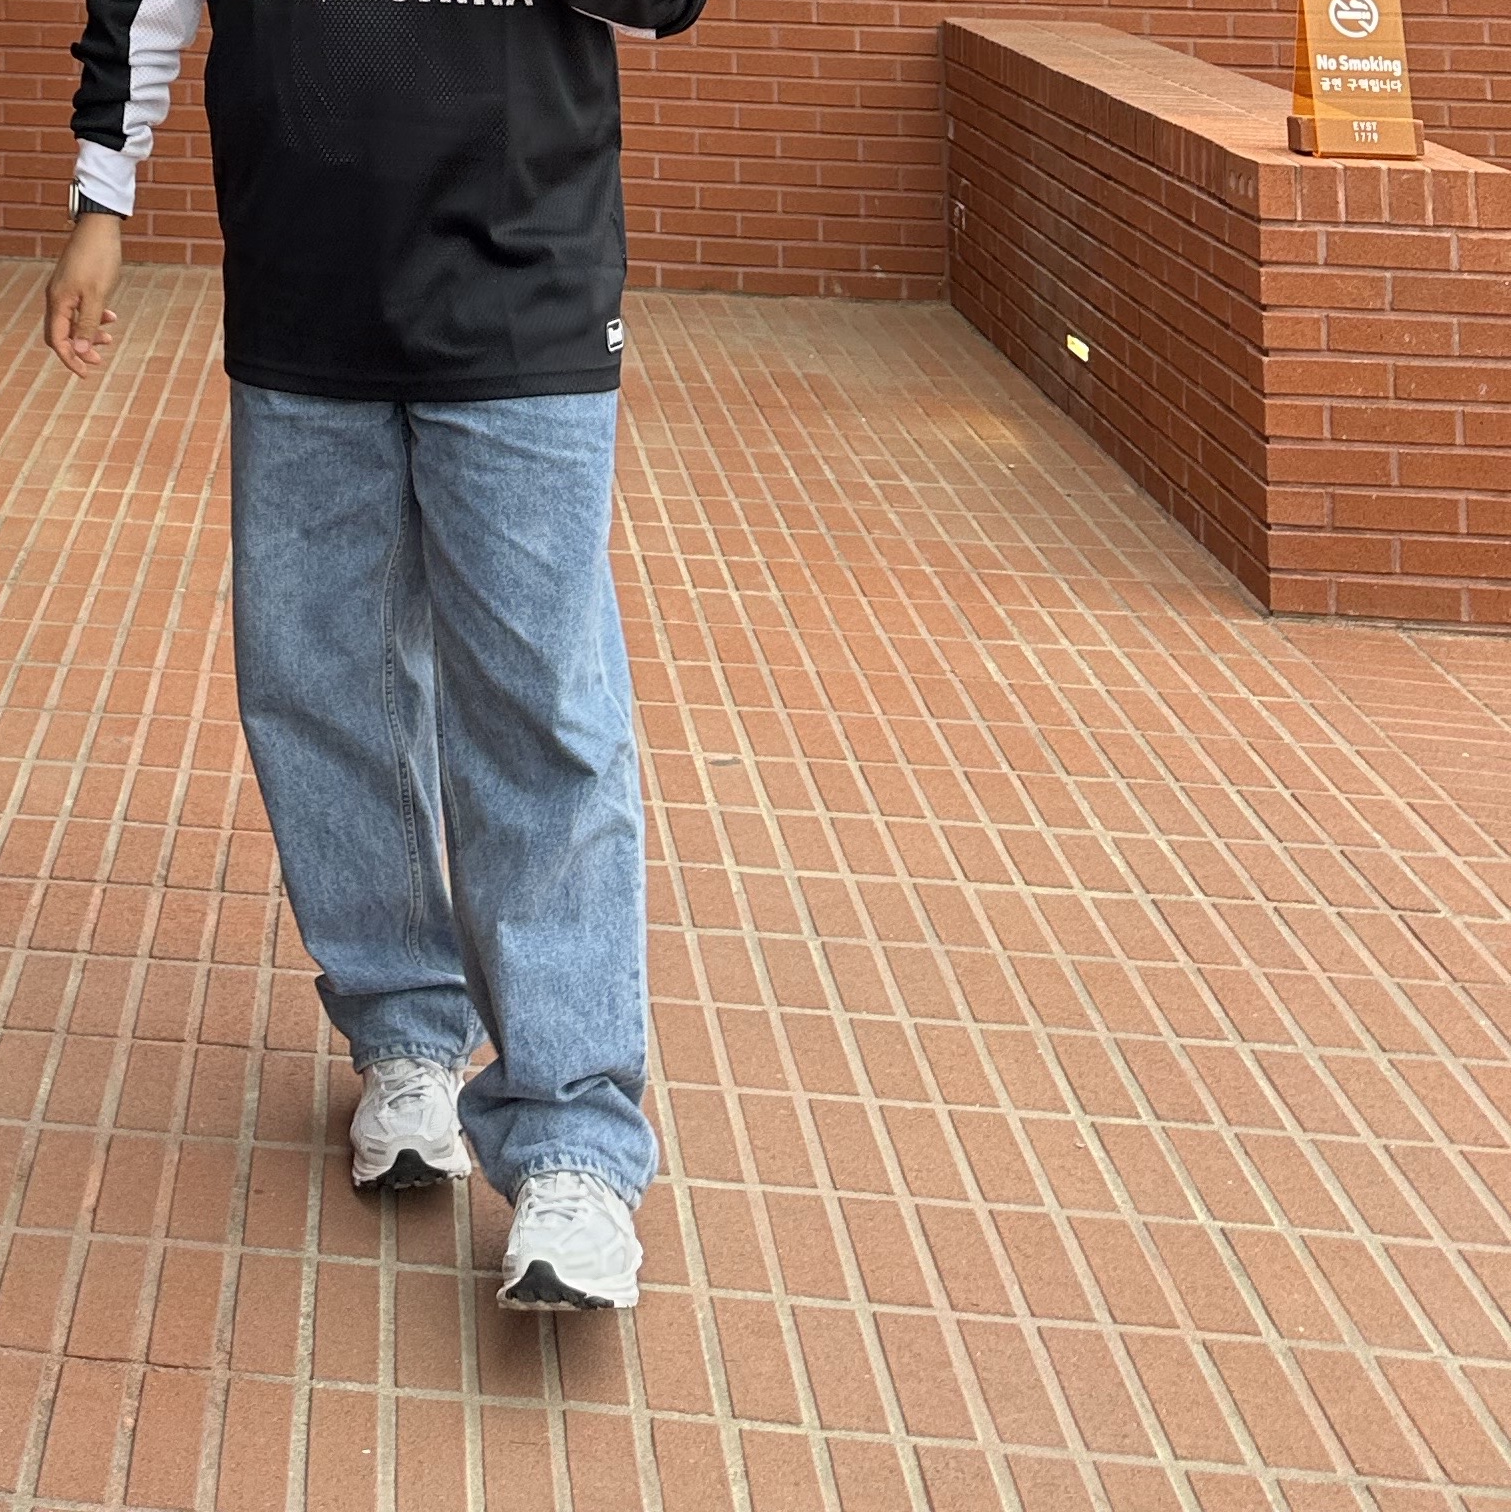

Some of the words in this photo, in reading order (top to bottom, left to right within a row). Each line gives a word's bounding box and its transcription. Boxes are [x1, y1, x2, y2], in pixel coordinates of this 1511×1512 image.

[1316, 54, 1337, 71] No
[1338, 55, 1402, 77] Smoking
[1320, 77, 1343, 92] 금연
[1347, 78, 1403, 93] 구역입니다
[1352, 121, 1378, 132] EYST
[1354, 132, 1379, 144] 1779
